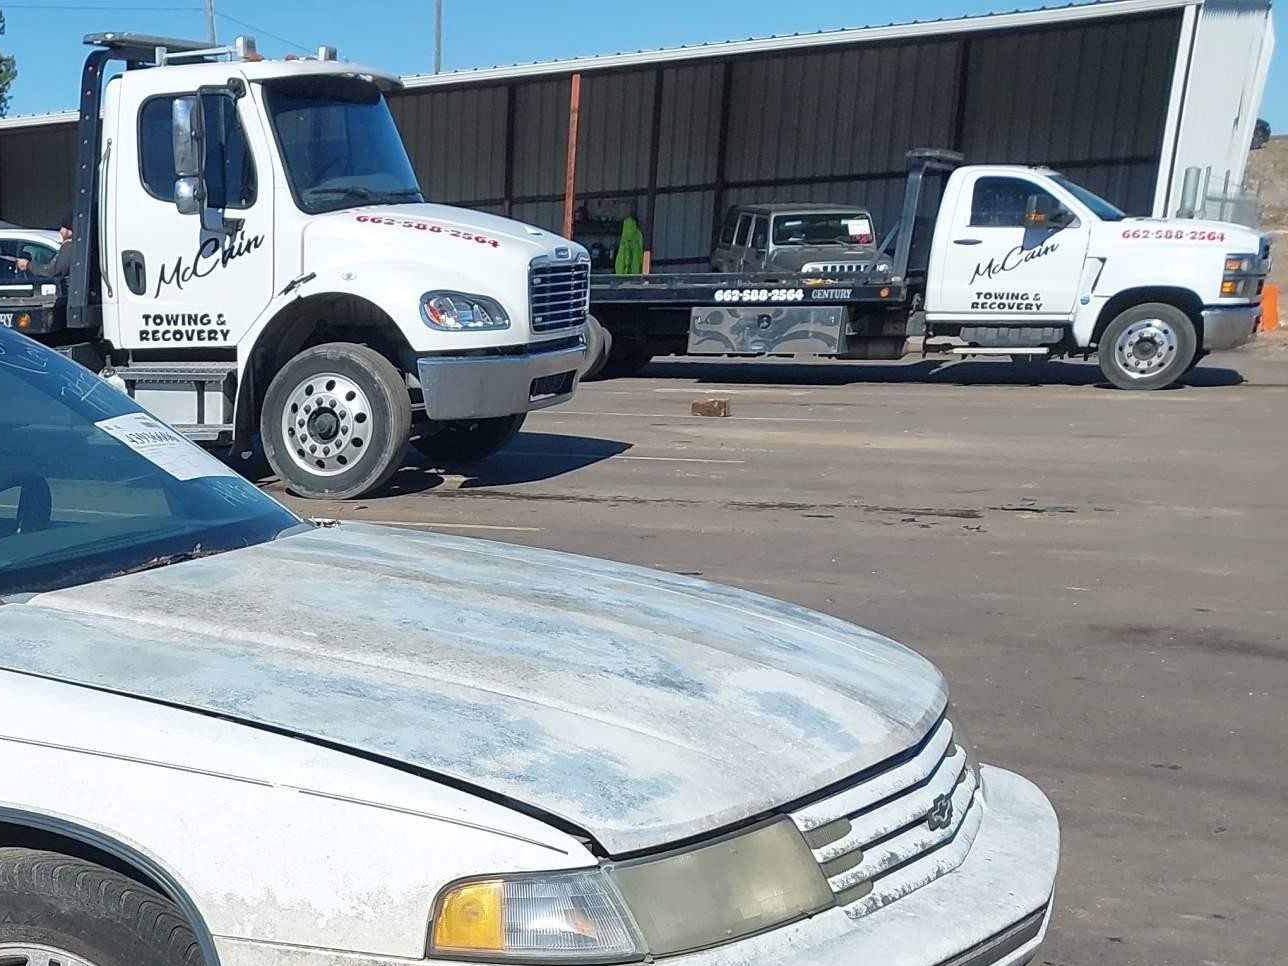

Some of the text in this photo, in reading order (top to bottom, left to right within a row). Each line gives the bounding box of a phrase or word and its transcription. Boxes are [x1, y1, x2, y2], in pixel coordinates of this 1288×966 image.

[356, 214, 500, 248] 662-588-2564
[1122, 229, 1225, 242] 662-588-2564
[714, 289, 852, 302] 662-588-2564 CENTURY
[976, 292, 1040, 301] TOWING &
[971, 302, 1043, 311] RECOVERY
[142, 313, 226, 326] TOWING &
[139, 329, 230, 341] RECOVERY
